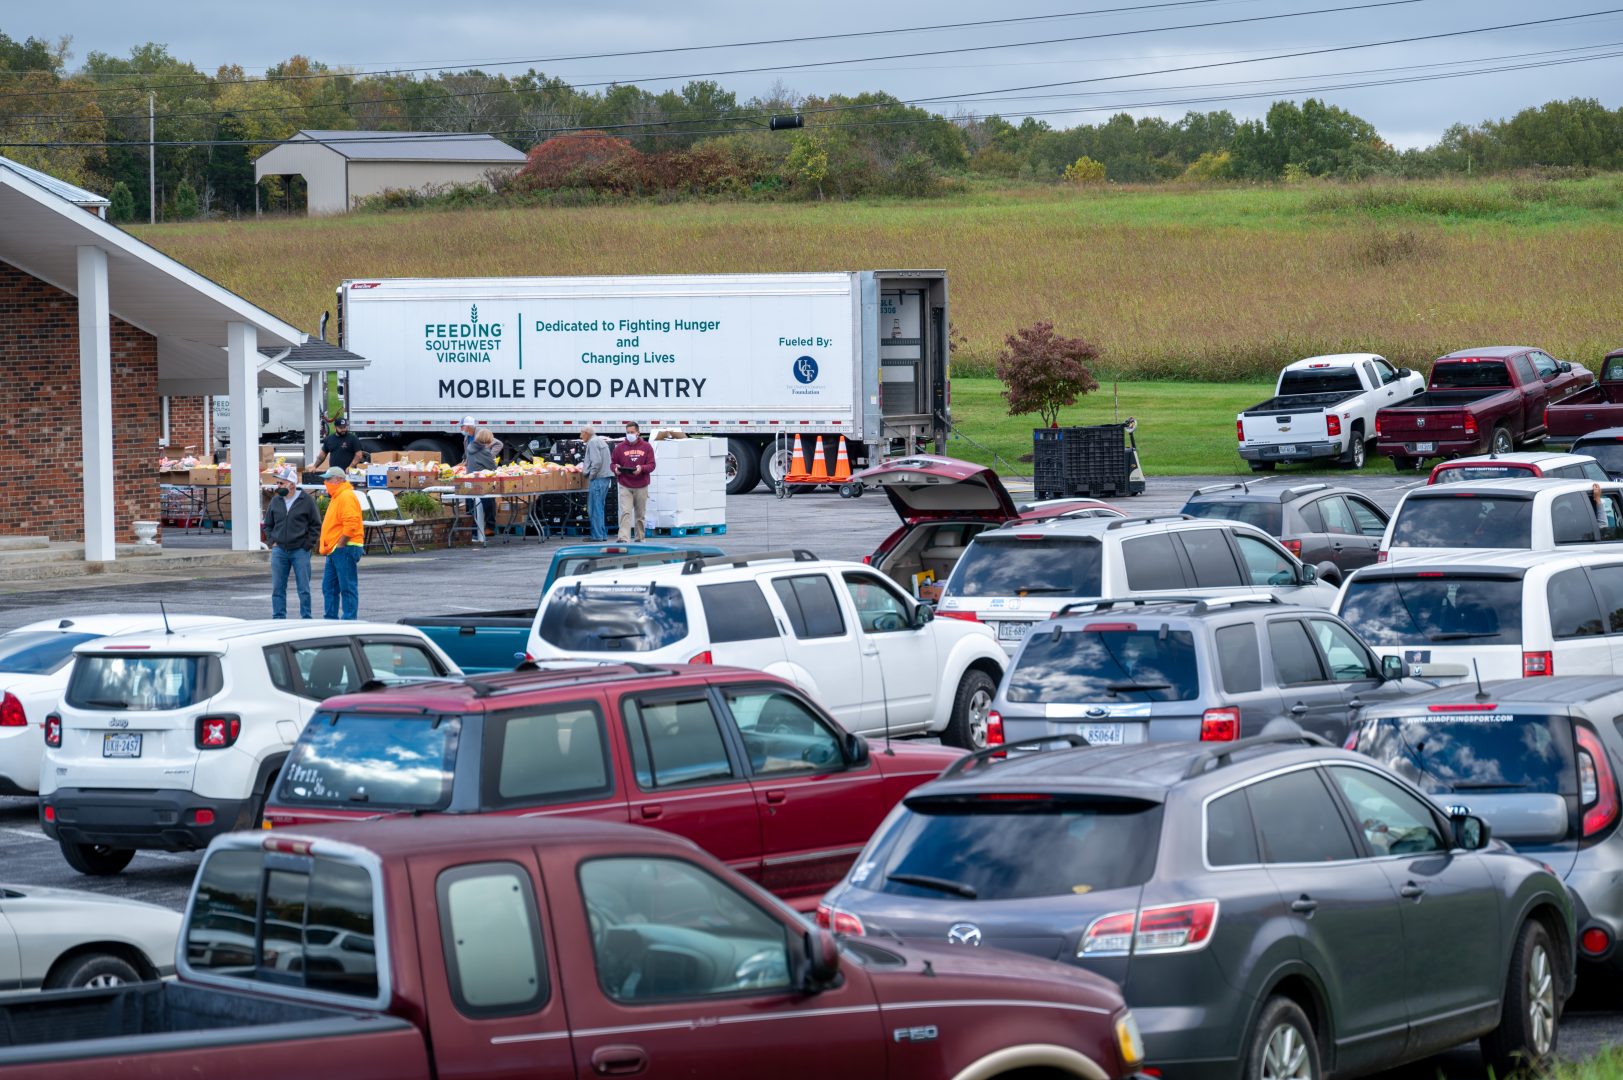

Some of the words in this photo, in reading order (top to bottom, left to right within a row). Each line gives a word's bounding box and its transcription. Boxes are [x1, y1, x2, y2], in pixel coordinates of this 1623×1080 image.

[425, 323, 501, 337] FEEDING
[536, 320, 598, 332] Dedicated
[602, 321, 615, 331] to
[619, 319, 670, 334] Fighting
[675, 319, 720, 334] Hunger
[425, 340, 501, 350] SOUTHWEST
[616, 337, 639, 348] and
[779, 336, 813, 347] Fueled
[817, 337, 832, 348] By:
[437, 352, 491, 363] VIRGINIA
[582, 352, 639, 366] Changing
[644, 352, 675, 363] Lives
[438, 378, 525, 399] MOBILE
[534, 378, 601, 398] FOOD
[611, 377, 706, 398] PANTRY
